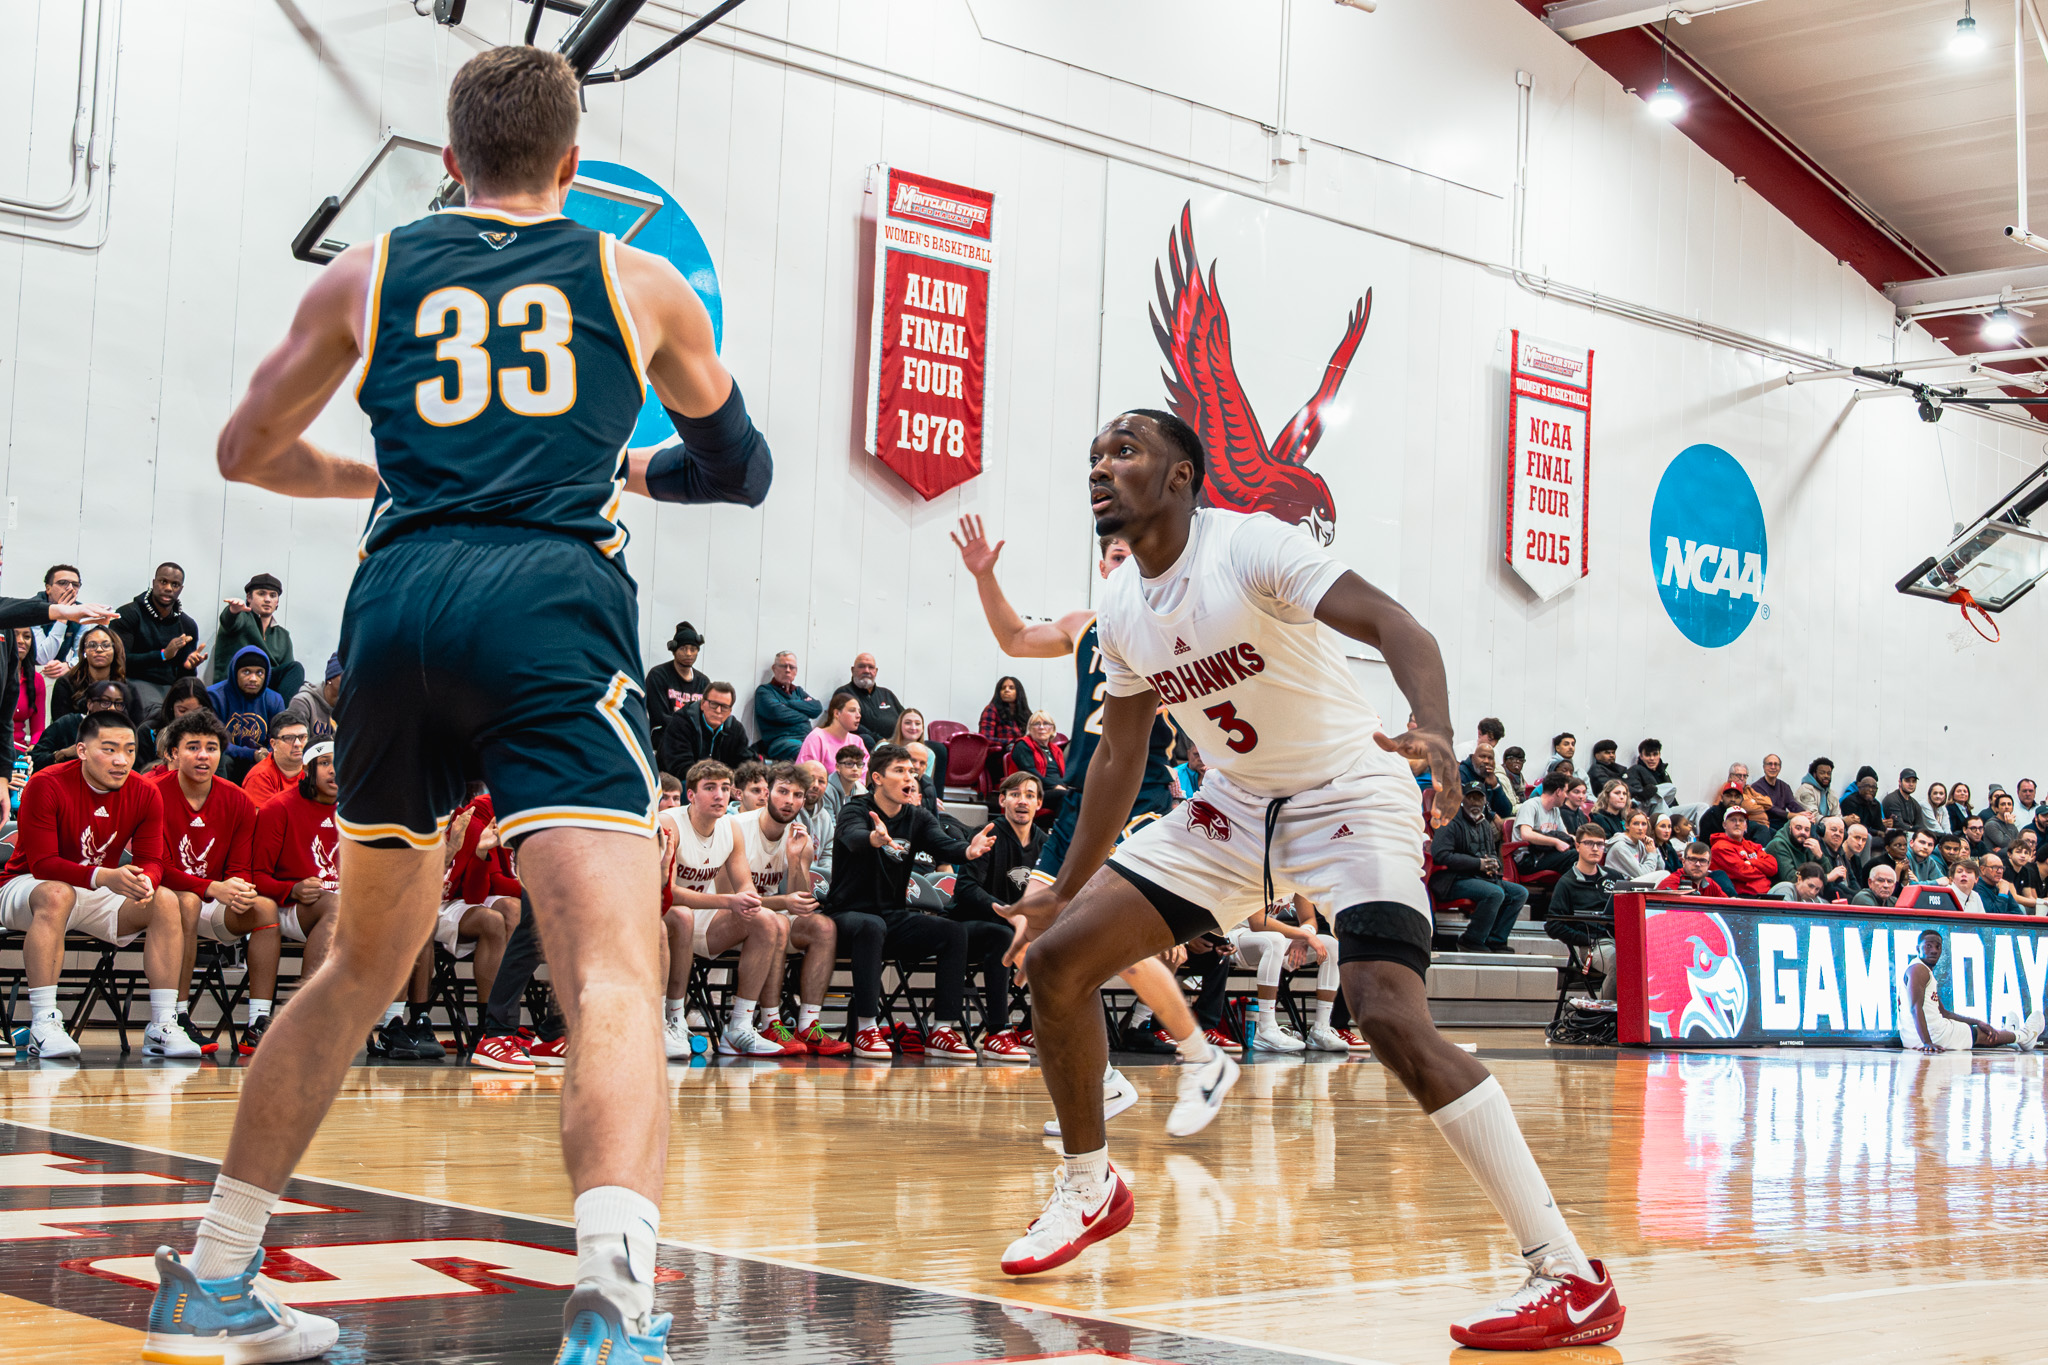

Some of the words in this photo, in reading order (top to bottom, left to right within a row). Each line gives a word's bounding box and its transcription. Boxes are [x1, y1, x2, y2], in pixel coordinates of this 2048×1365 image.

[894, 185, 957, 214] MONTCLAIR
[957, 204, 985, 220] STATE
[884, 225, 930, 248] WOMEN'S
[932, 236, 992, 263] BASKETBALL
[904, 273, 968, 317] AIAW
[415, 283, 577, 427] 33
[900, 313, 969, 359] FINAL
[902, 355, 963, 400] FOUR
[897, 408, 964, 458] 1978
[1529, 416, 1572, 451] NCAA
[1526, 450, 1572, 485] FINAL
[1528, 484, 1569, 518] FOUR
[1526, 528, 1570, 566] 2015
[1661, 535, 1761, 603] NCAA
[1202, 700, 1259, 754] 3
